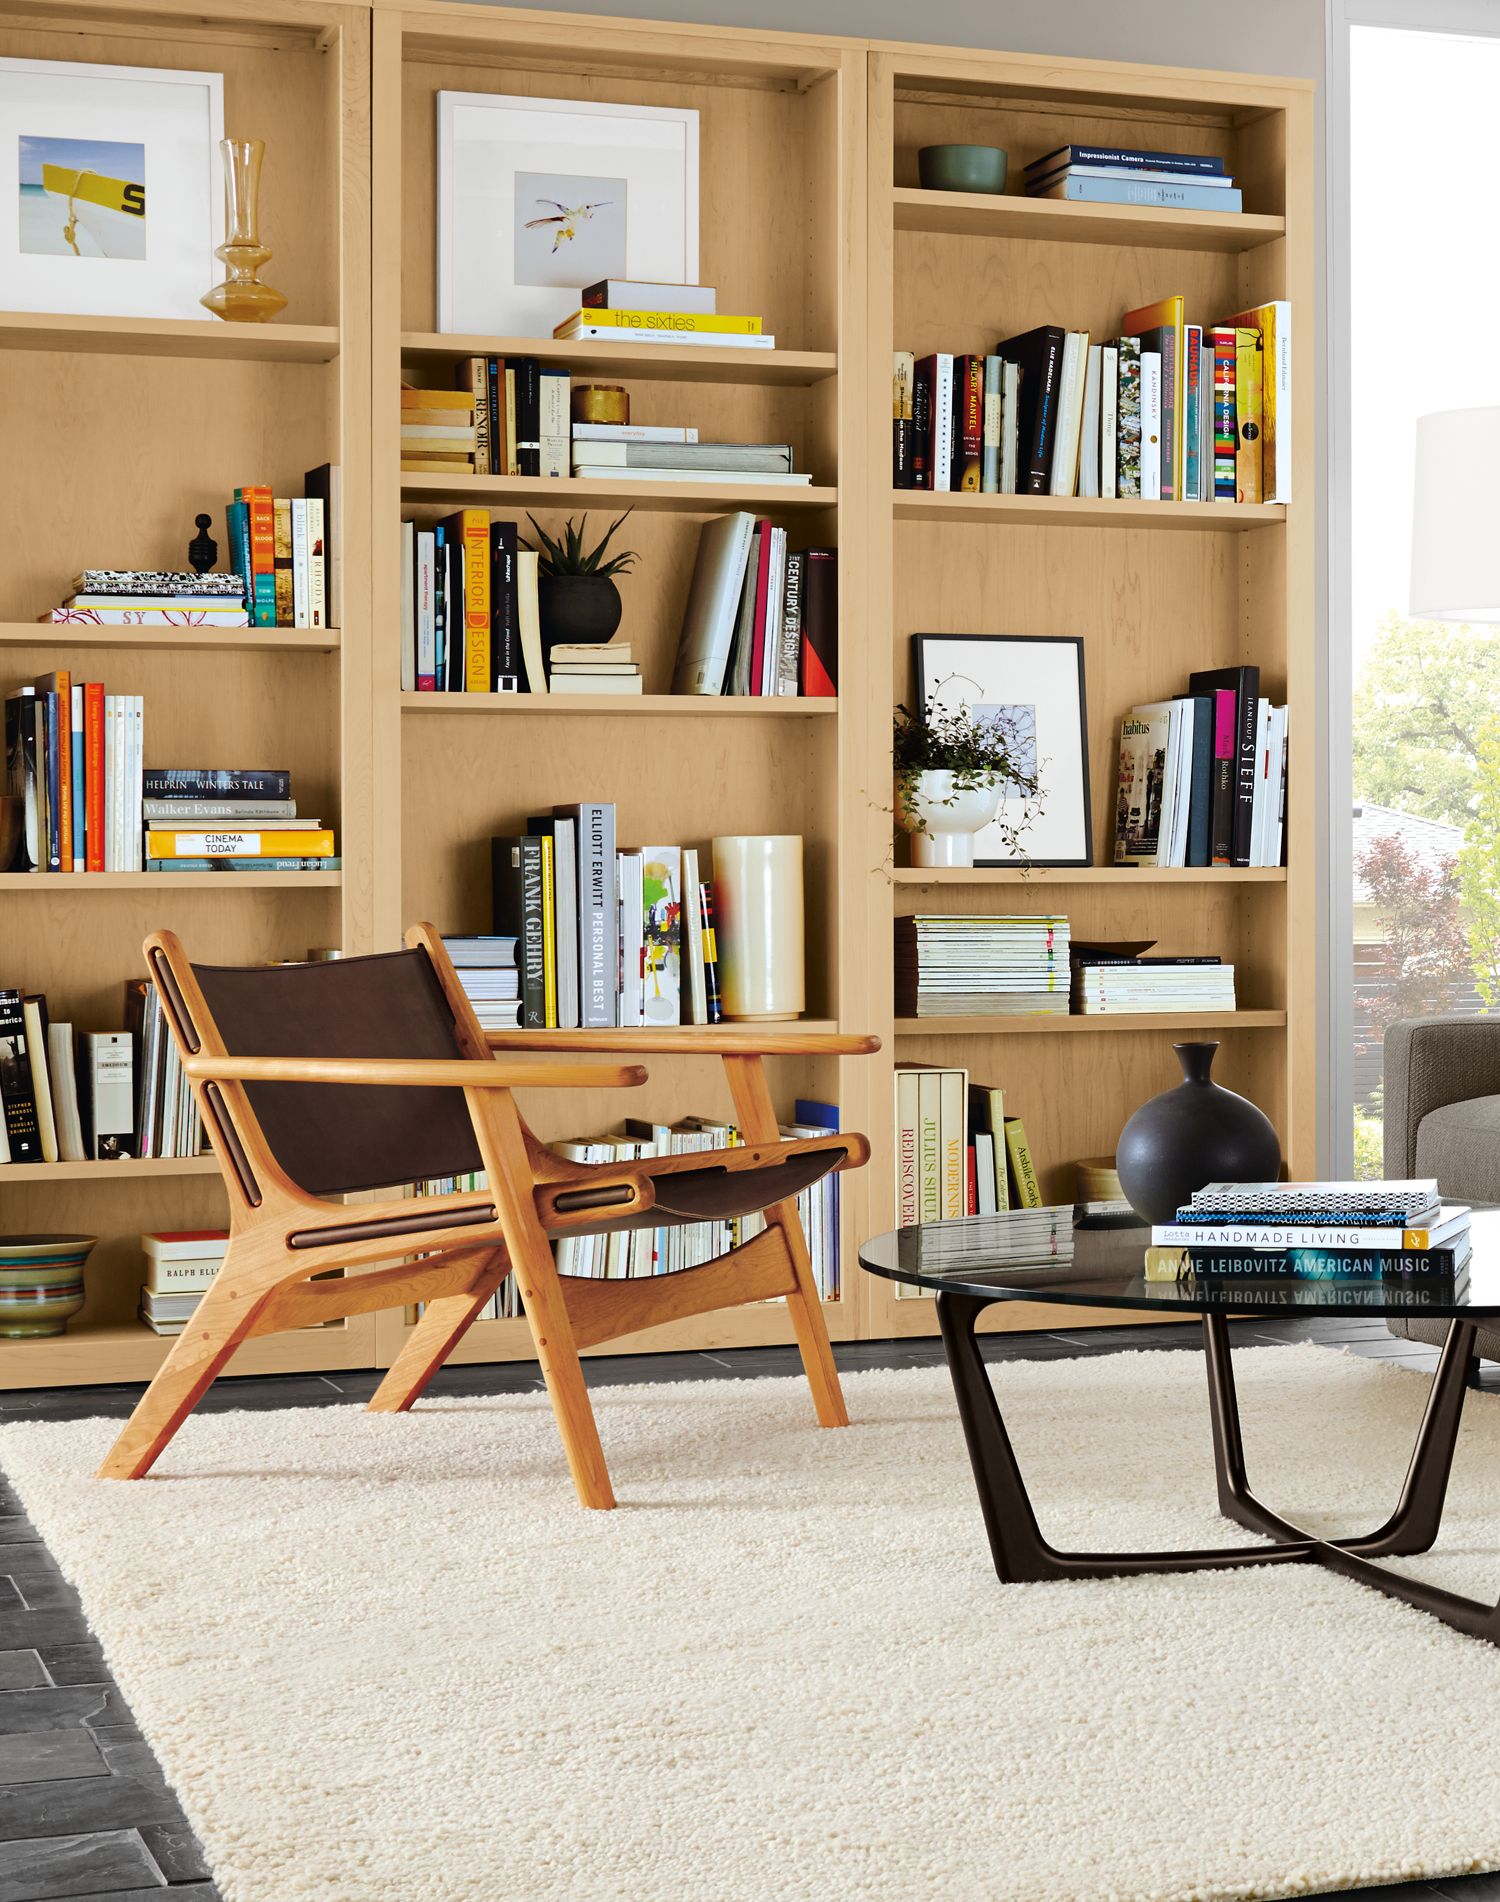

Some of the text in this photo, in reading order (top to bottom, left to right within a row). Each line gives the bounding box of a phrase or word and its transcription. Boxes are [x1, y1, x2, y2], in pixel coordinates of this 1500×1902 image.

[1079, 151, 1120, 165] Impressionist
[1121, 154, 1144, 163] Camera
[615, 311, 696, 331] the sixties
[1189, 329, 1199, 387] BAUHAUS
[914, 381, 923, 432] Mockingbird
[969, 361, 978, 430] HILARY MANTEL
[475, 397, 489, 450] RENOIR
[1106, 412, 1114, 437] Things
[297, 514, 306, 539] blink
[314, 561, 323, 605] RHODA
[467, 528, 488, 608] INTERIOR
[784, 561, 800, 660] CENTURY DESIGN
[467, 612, 488, 676] DESIGN
[1123, 720, 1151, 737] habitus
[1239, 697, 1255, 804] JEANLOUP SIEFF
[146, 781, 188, 790] HELPRIN
[243, 780, 265, 790] TALE
[1220, 761, 1229, 790] Rothko
[145, 803, 193, 816] Walker
[194, 804, 233, 816] Evans
[204, 834, 244, 843] CINEMA
[206, 844, 238, 853] TODAY
[592, 809, 603, 857] ELLIOTT
[276, 861, 300, 871] Freud
[524, 845, 542, 913] FRANK
[592, 862, 603, 908] ERWITT
[525, 917, 543, 983] GEHRY
[592, 912, 604, 976] PERSONAL
[593, 980, 605, 1011] BEST
[924, 1117, 937, 1172] JULIUS
[998, 1167, 1006, 1179] The
[999, 1179, 1007, 1195] Color
[1017, 1146, 1040, 1208] Arshile Gorky
[1163, 1230, 1360, 1245] Lotta HANDMADE LIVING
[167, 1268, 197, 1278] RALPH
[1157, 1257, 1431, 1273] ANNIE LEIBOVITZ AMERICAN MUSIC
